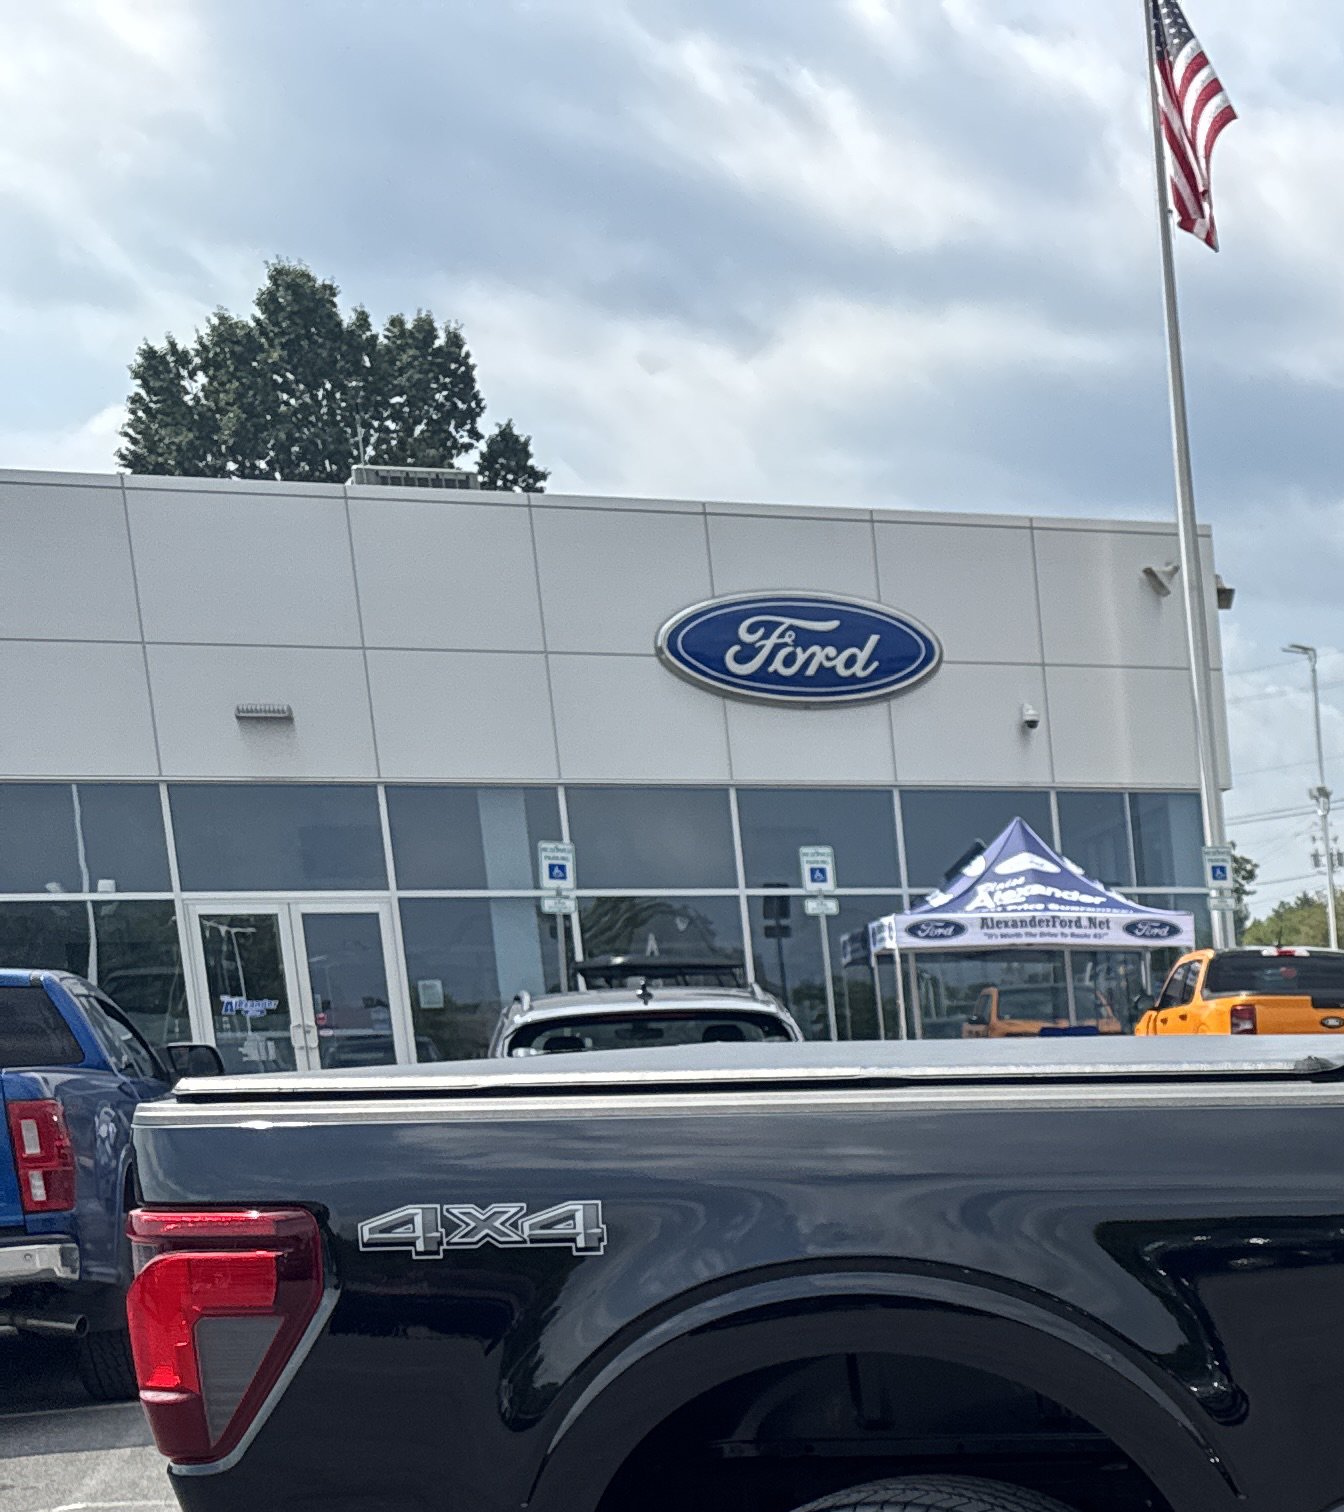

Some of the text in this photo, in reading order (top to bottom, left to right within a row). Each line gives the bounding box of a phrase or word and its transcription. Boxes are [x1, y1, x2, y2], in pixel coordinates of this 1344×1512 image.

[724, 614, 881, 677] Ford
[965, 884, 1107, 912] Alexander
[917, 921, 955, 937] Ford
[980, 915, 1111, 931] AlexanderFord.Net
[1134, 921, 1170, 937] Ford
